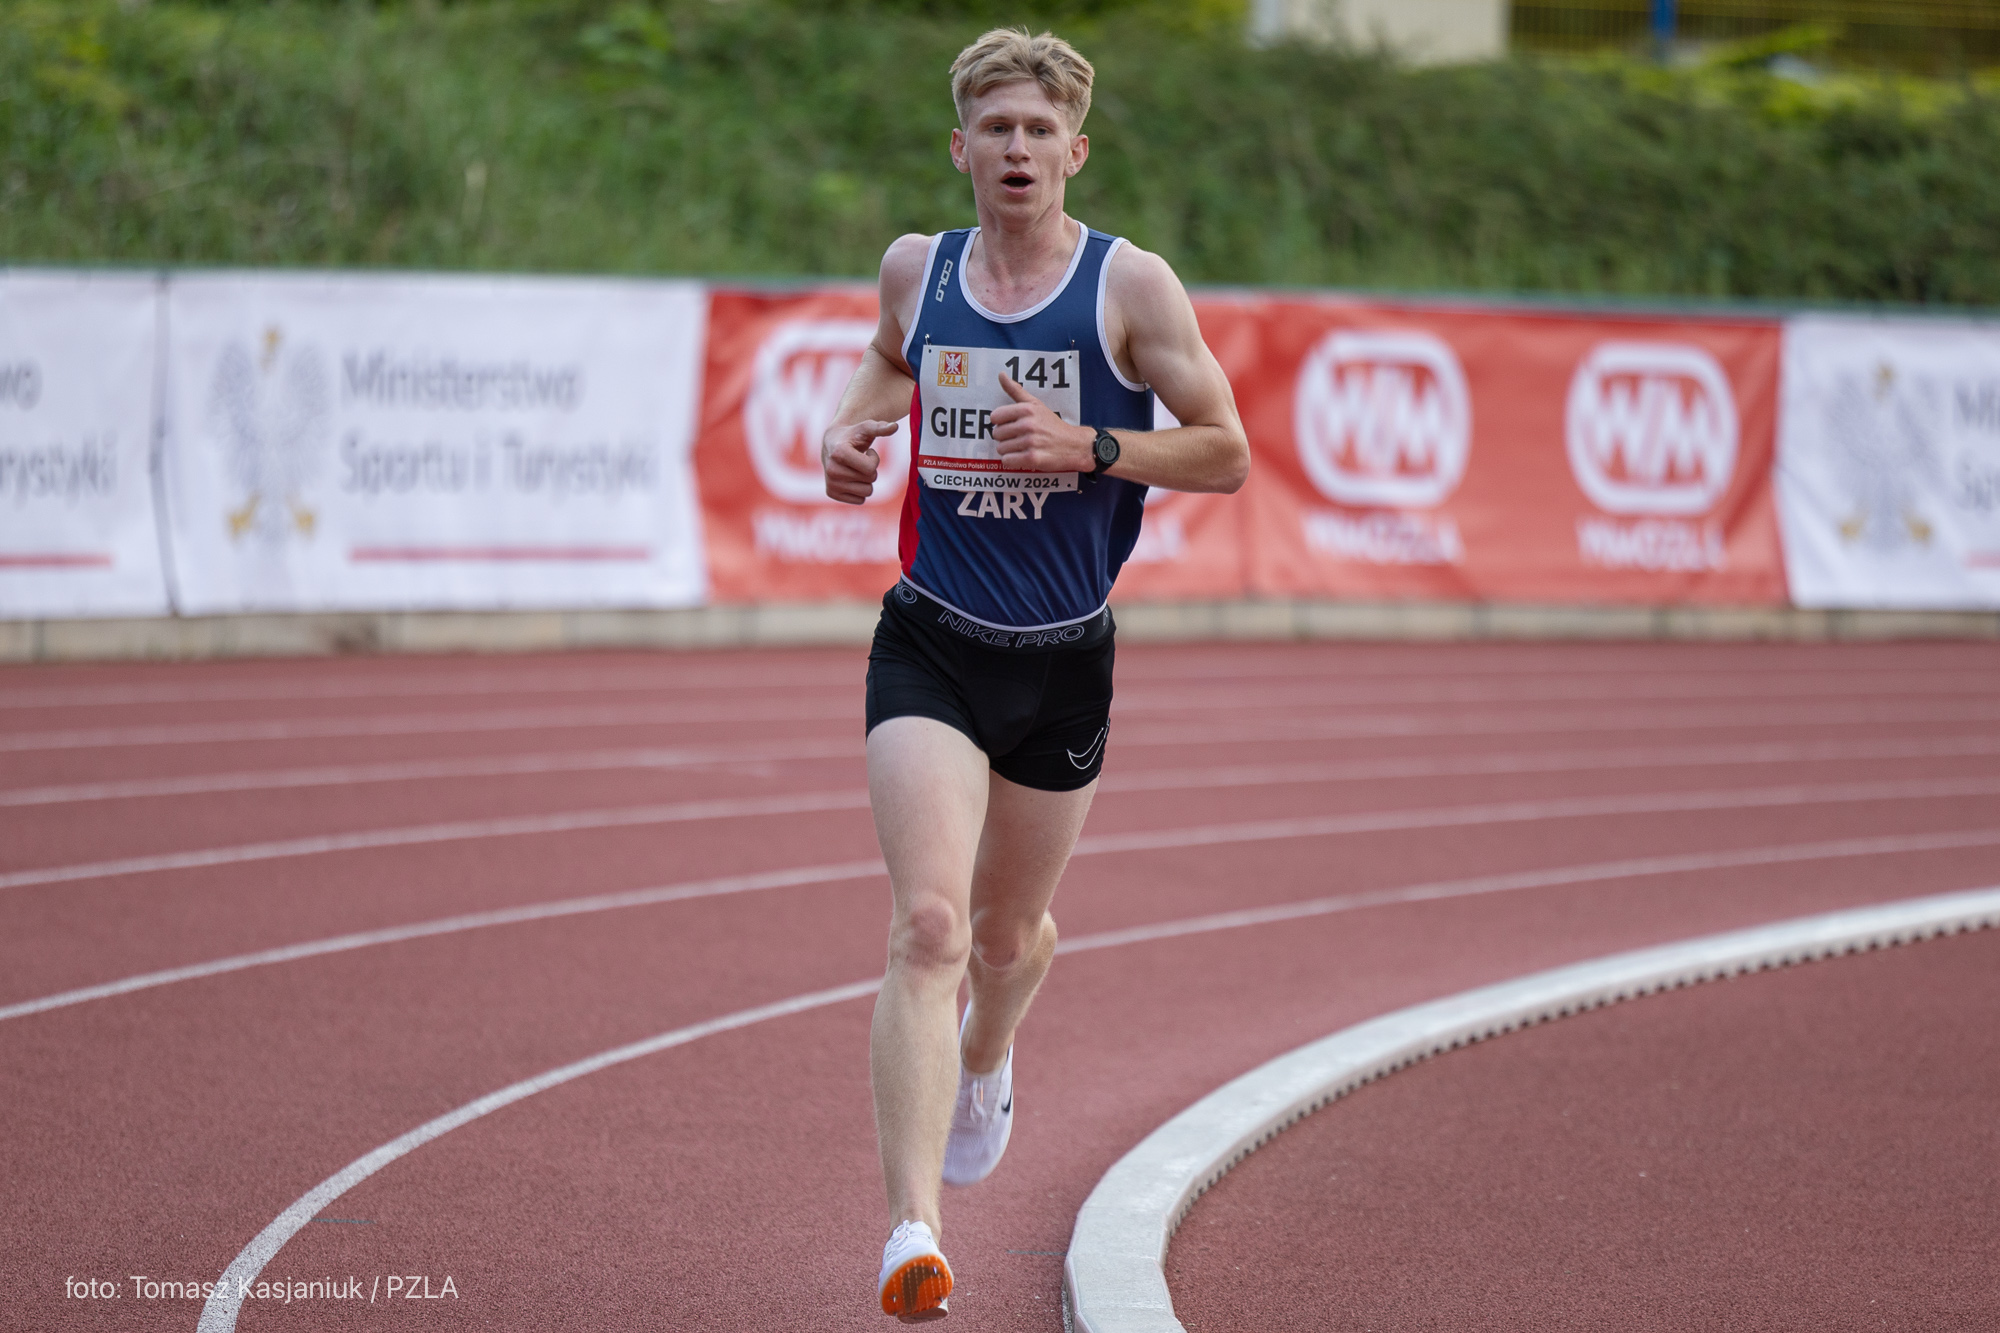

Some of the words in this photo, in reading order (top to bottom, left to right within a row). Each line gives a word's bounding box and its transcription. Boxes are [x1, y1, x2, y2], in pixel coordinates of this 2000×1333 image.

[935, 259, 954, 303] COLO
[341, 350, 585, 412] Ministerstwo
[939, 375, 966, 386] PZLA
[1005, 356, 1070, 389] 141
[933, 474, 1022, 488] CIECHANÓW
[1024, 477, 1060, 488] 2024
[938, 610, 1014, 647] NIKE
[1015, 625, 1085, 648] PRO
